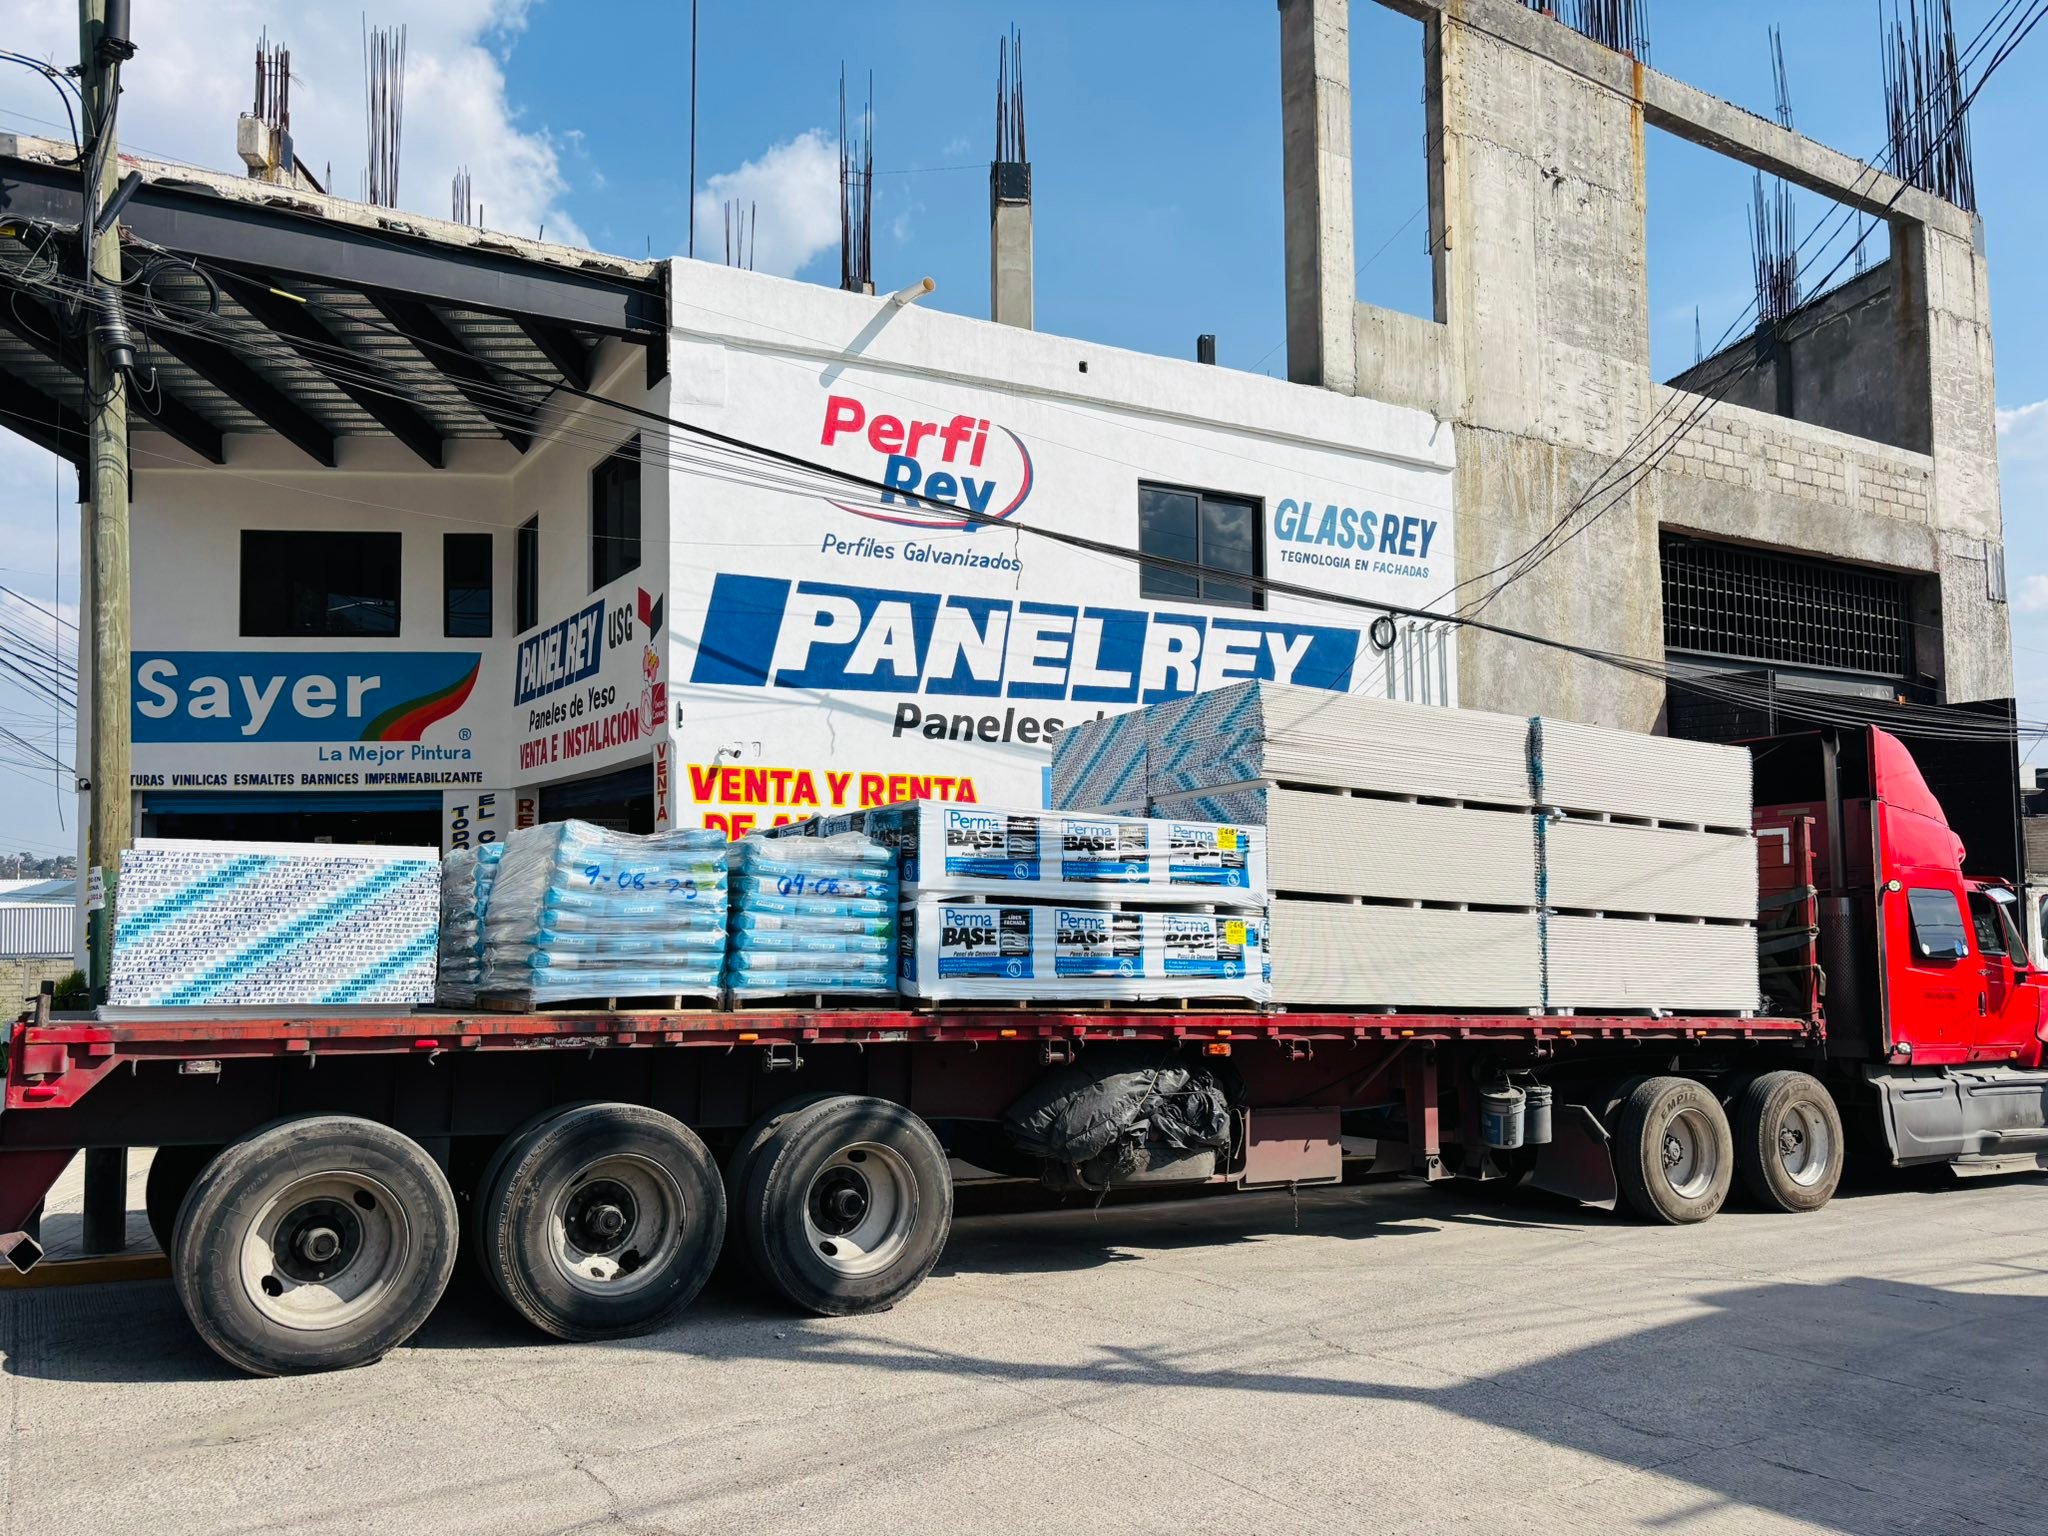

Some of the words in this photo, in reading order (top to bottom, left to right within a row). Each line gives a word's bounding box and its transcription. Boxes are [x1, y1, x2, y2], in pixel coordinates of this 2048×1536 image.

[820, 394, 990, 467] Perfi
[880, 453, 997, 532] Rey
[821, 533, 895, 559] Perfiles
[903, 542, 1021, 572] Galvanizados
[1355, 559, 1369, 571] EN
[1373, 561, 1429, 578] FACHADAS
[608, 603, 633, 649] USG
[136, 658, 381, 736] Sayer
[528, 703, 567, 732] Paneles
[569, 693, 584, 718] de
[588, 684, 616, 713] Yeso
[519, 737, 548, 770] VENTA
[551, 732, 558, 763] E
[563, 701, 640, 760] INSTALACIÓN
[892, 702, 1064, 744] Paneles
[318, 746, 342, 762] La
[349, 745, 405, 767] Mejor
[411, 744, 472, 761] Pintura
[172, 774, 228, 786] VINILICAS
[234, 773, 295, 785] ESMALTES
[301, 773, 359, 785] BARNICES
[365, 771, 483, 785] IMPERMEABILIZANTE
[656, 742, 668, 821] VENTA
[687, 765, 820, 807] VENTA
[825, 771, 852, 807] Y
[860, 772, 978, 808] RENTA
[947, 829, 1005, 850] BASE
[1064, 835, 1117, 855] BASE
[945, 909, 993, 927] Perma
[1060, 912, 1106, 930] Perma
[942, 927, 997, 950] BASE
